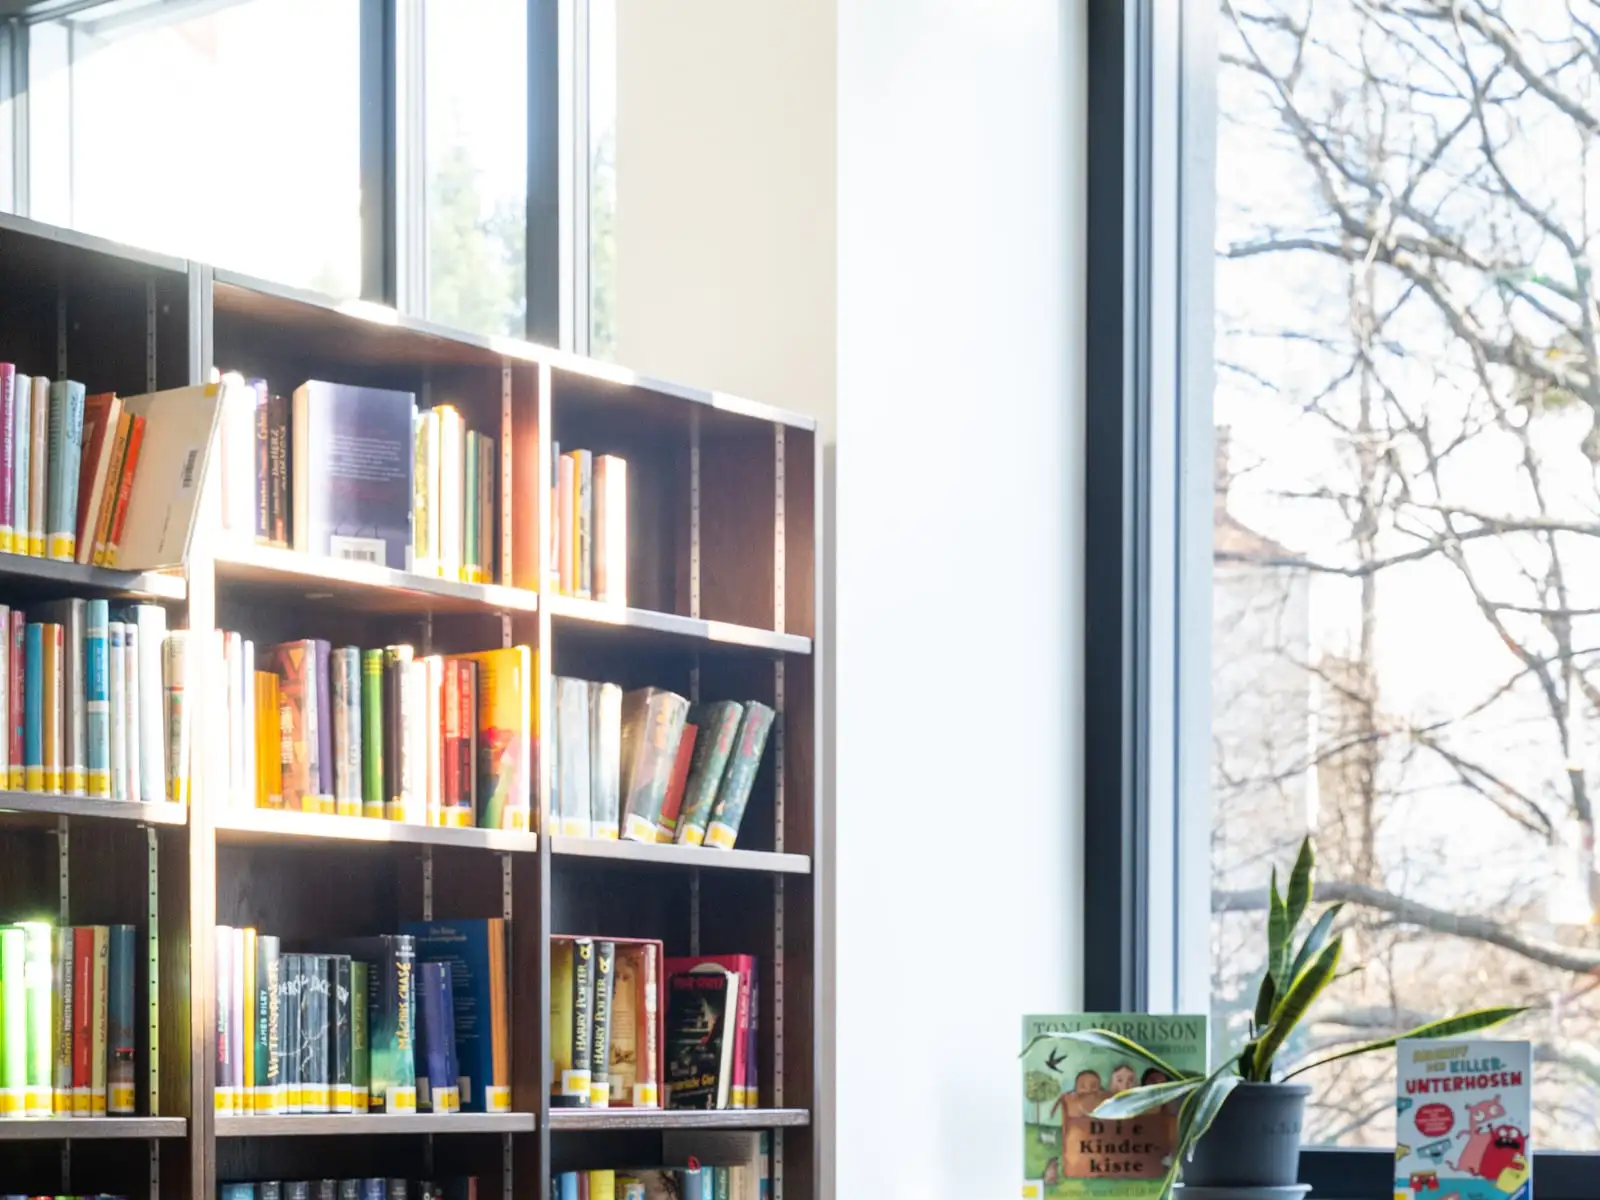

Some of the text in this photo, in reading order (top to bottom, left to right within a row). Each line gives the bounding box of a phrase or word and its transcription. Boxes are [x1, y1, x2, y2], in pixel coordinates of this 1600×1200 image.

[395, 961, 412, 1000] CHASE
[594, 977, 606, 1064] HARRY POTTER
[1090, 1021, 1198, 1040] MORRISON
[260, 1017, 268, 1046] JAMES
[575, 1012, 586, 1052] HARRY
[1450, 1057, 1507, 1074] KILLER-
[1405, 1071, 1522, 1095] UNTERHOSEN
[1090, 1121, 1143, 1135] Die
[1080, 1140, 1159, 1154] Kinder-
[1090, 1159, 1144, 1173] kiste
